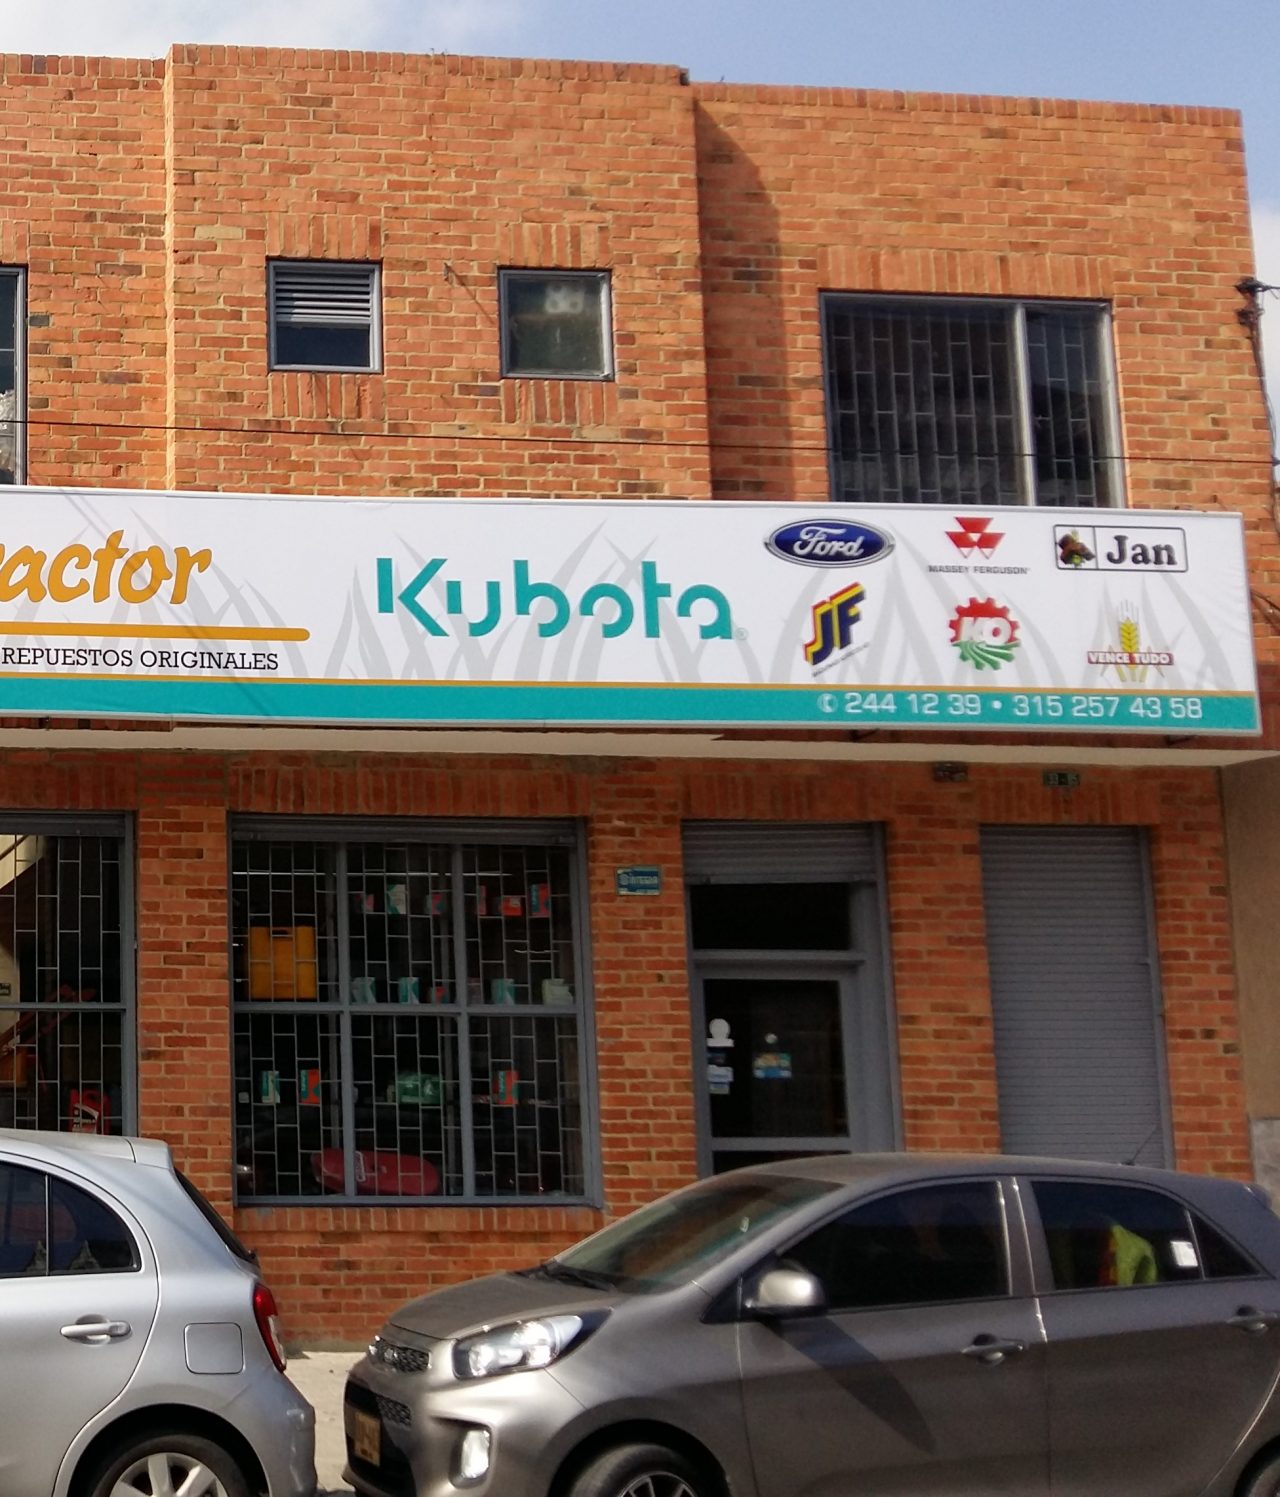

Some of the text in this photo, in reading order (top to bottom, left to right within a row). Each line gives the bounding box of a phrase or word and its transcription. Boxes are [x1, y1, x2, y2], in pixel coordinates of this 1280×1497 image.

[792, 526, 865, 557] Ford
[1106, 534, 1178, 566] Jan
[928, 564, 1029, 575] MASSEY FERGUSON
[375, 557, 734, 640] Kubota
[802, 581, 866, 666] JF
[1, 646, 133, 668] REPUESTOS
[139, 650, 280, 671] ORIGINALES
[1088, 652, 1170, 665] VENCE TUDO
[844, 692, 1203, 719] 244 12 39 315 257 43 58
